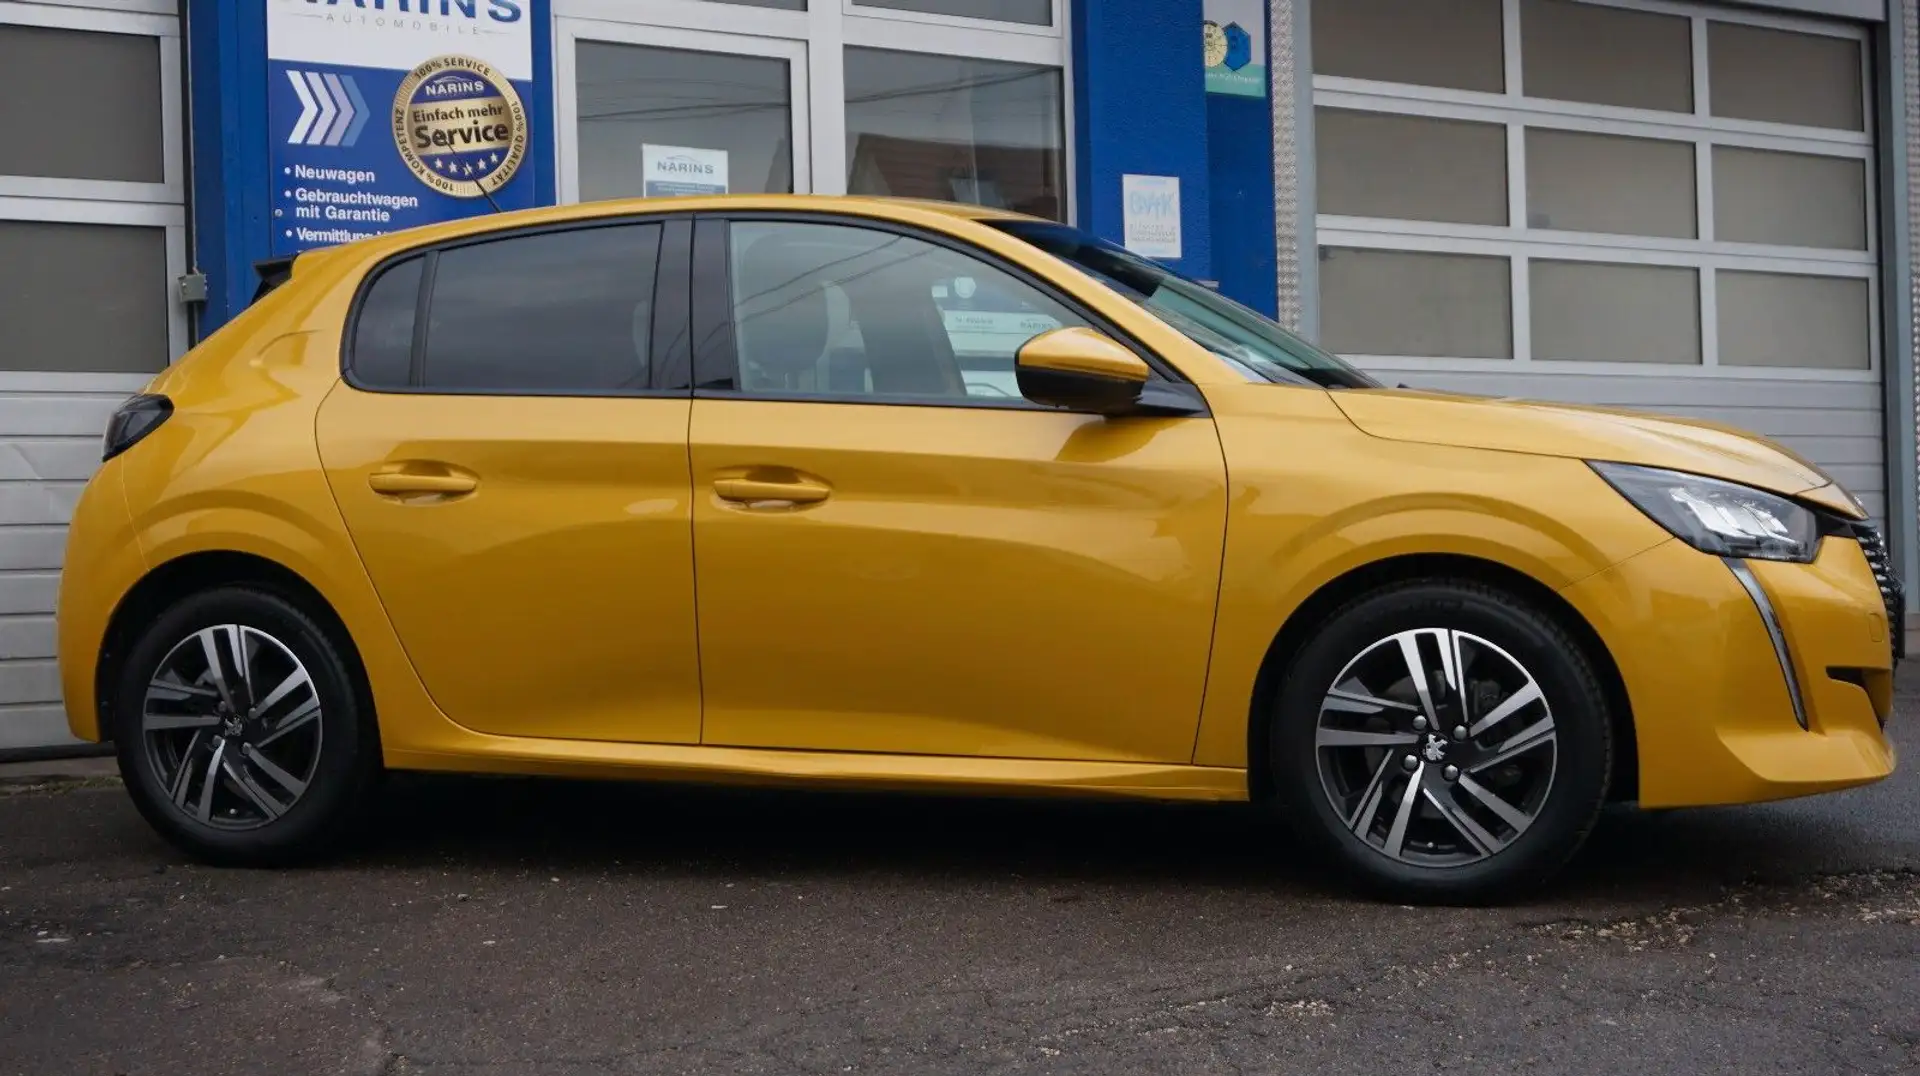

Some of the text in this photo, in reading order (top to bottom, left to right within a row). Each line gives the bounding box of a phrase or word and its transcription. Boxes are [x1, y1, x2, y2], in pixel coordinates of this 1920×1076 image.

[326, 14, 479, 35] AUTOMOBILE
[444, 57, 490, 77] SERVICE
[425, 80, 485, 96] NARINS
[413, 103, 504, 122] Einfach mehr
[394, 108, 425, 175] KOMPETENZ
[414, 119, 509, 148] Service
[492, 134, 525, 186] QUALITÄT
[657, 160, 714, 174] NARINS
[295, 164, 375, 184] Neuwagen
[295, 187, 418, 209] Gebrauchtwagen
[296, 205, 390, 222] mit Garantie
